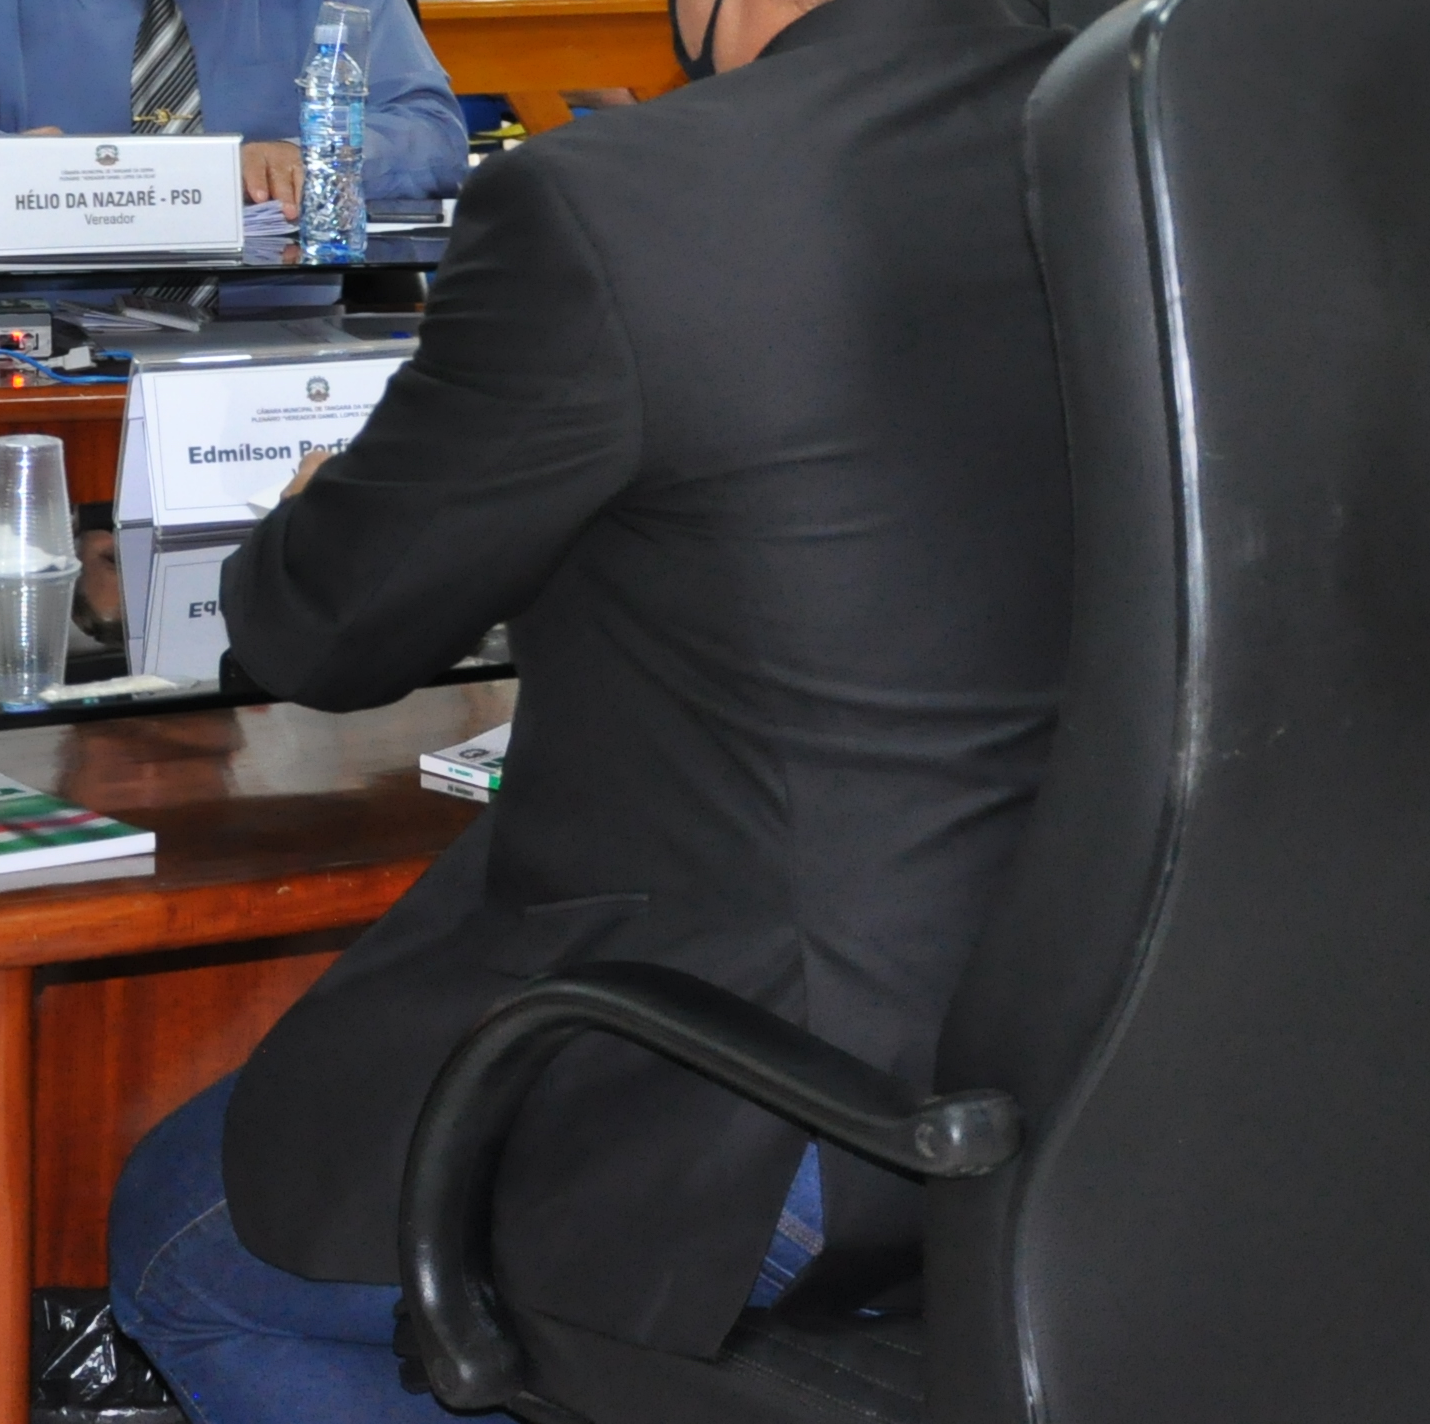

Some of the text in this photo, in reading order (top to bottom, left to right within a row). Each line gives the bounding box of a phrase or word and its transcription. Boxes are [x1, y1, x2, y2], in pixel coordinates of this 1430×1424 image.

[15, 189, 60, 210] HÉLIO
[66, 192, 88, 208] DA
[93, 186, 157, 208] NAZARÉ
[170, 188, 202, 205] PSD
[84, 212, 135, 225] Vereador
[188, 442, 292, 465] Edmílson
